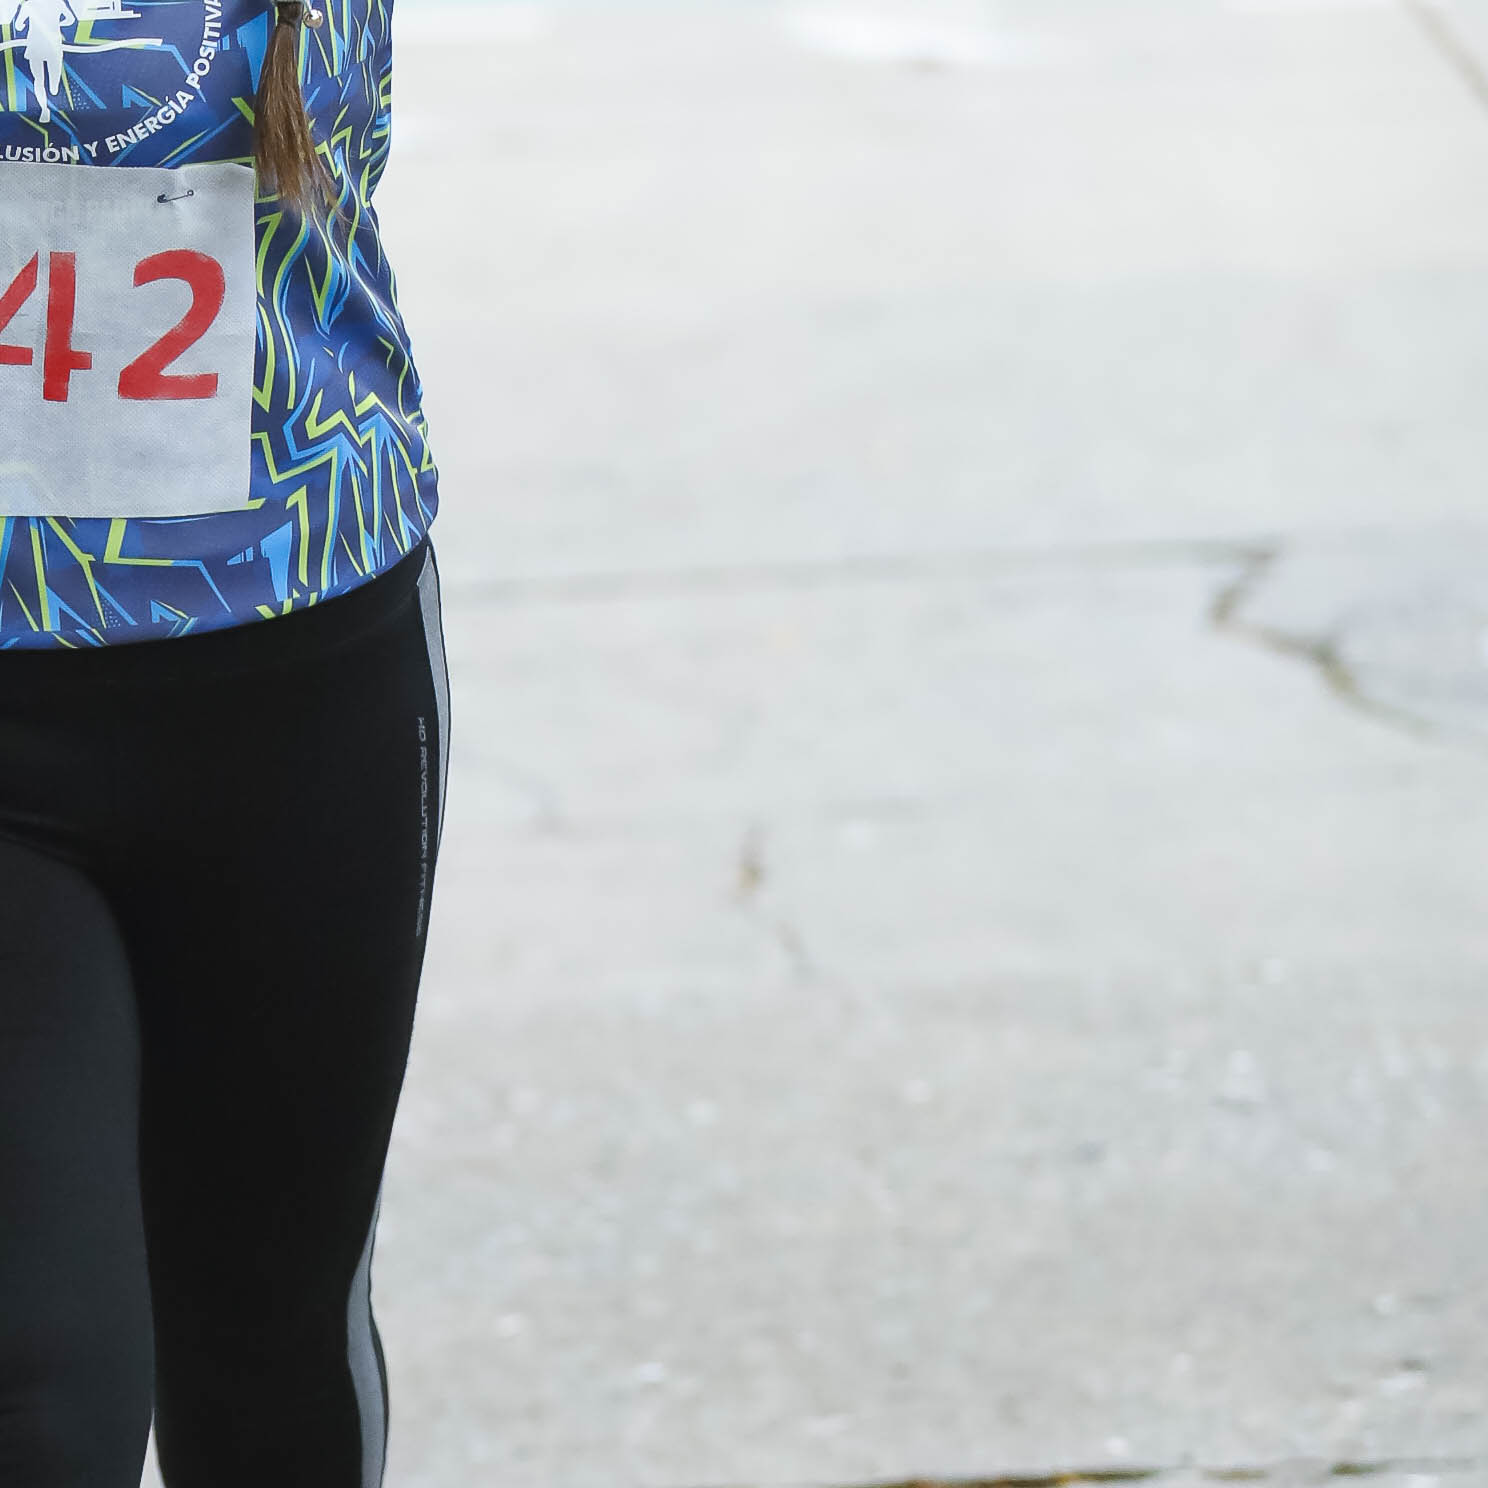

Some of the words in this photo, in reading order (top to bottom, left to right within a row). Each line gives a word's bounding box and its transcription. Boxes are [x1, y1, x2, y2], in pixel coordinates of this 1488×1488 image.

[83, 141, 99, 158] Y
[104, 89, 196, 153] ENERGÍA
[420, 746, 428, 859] REVOLUTION
